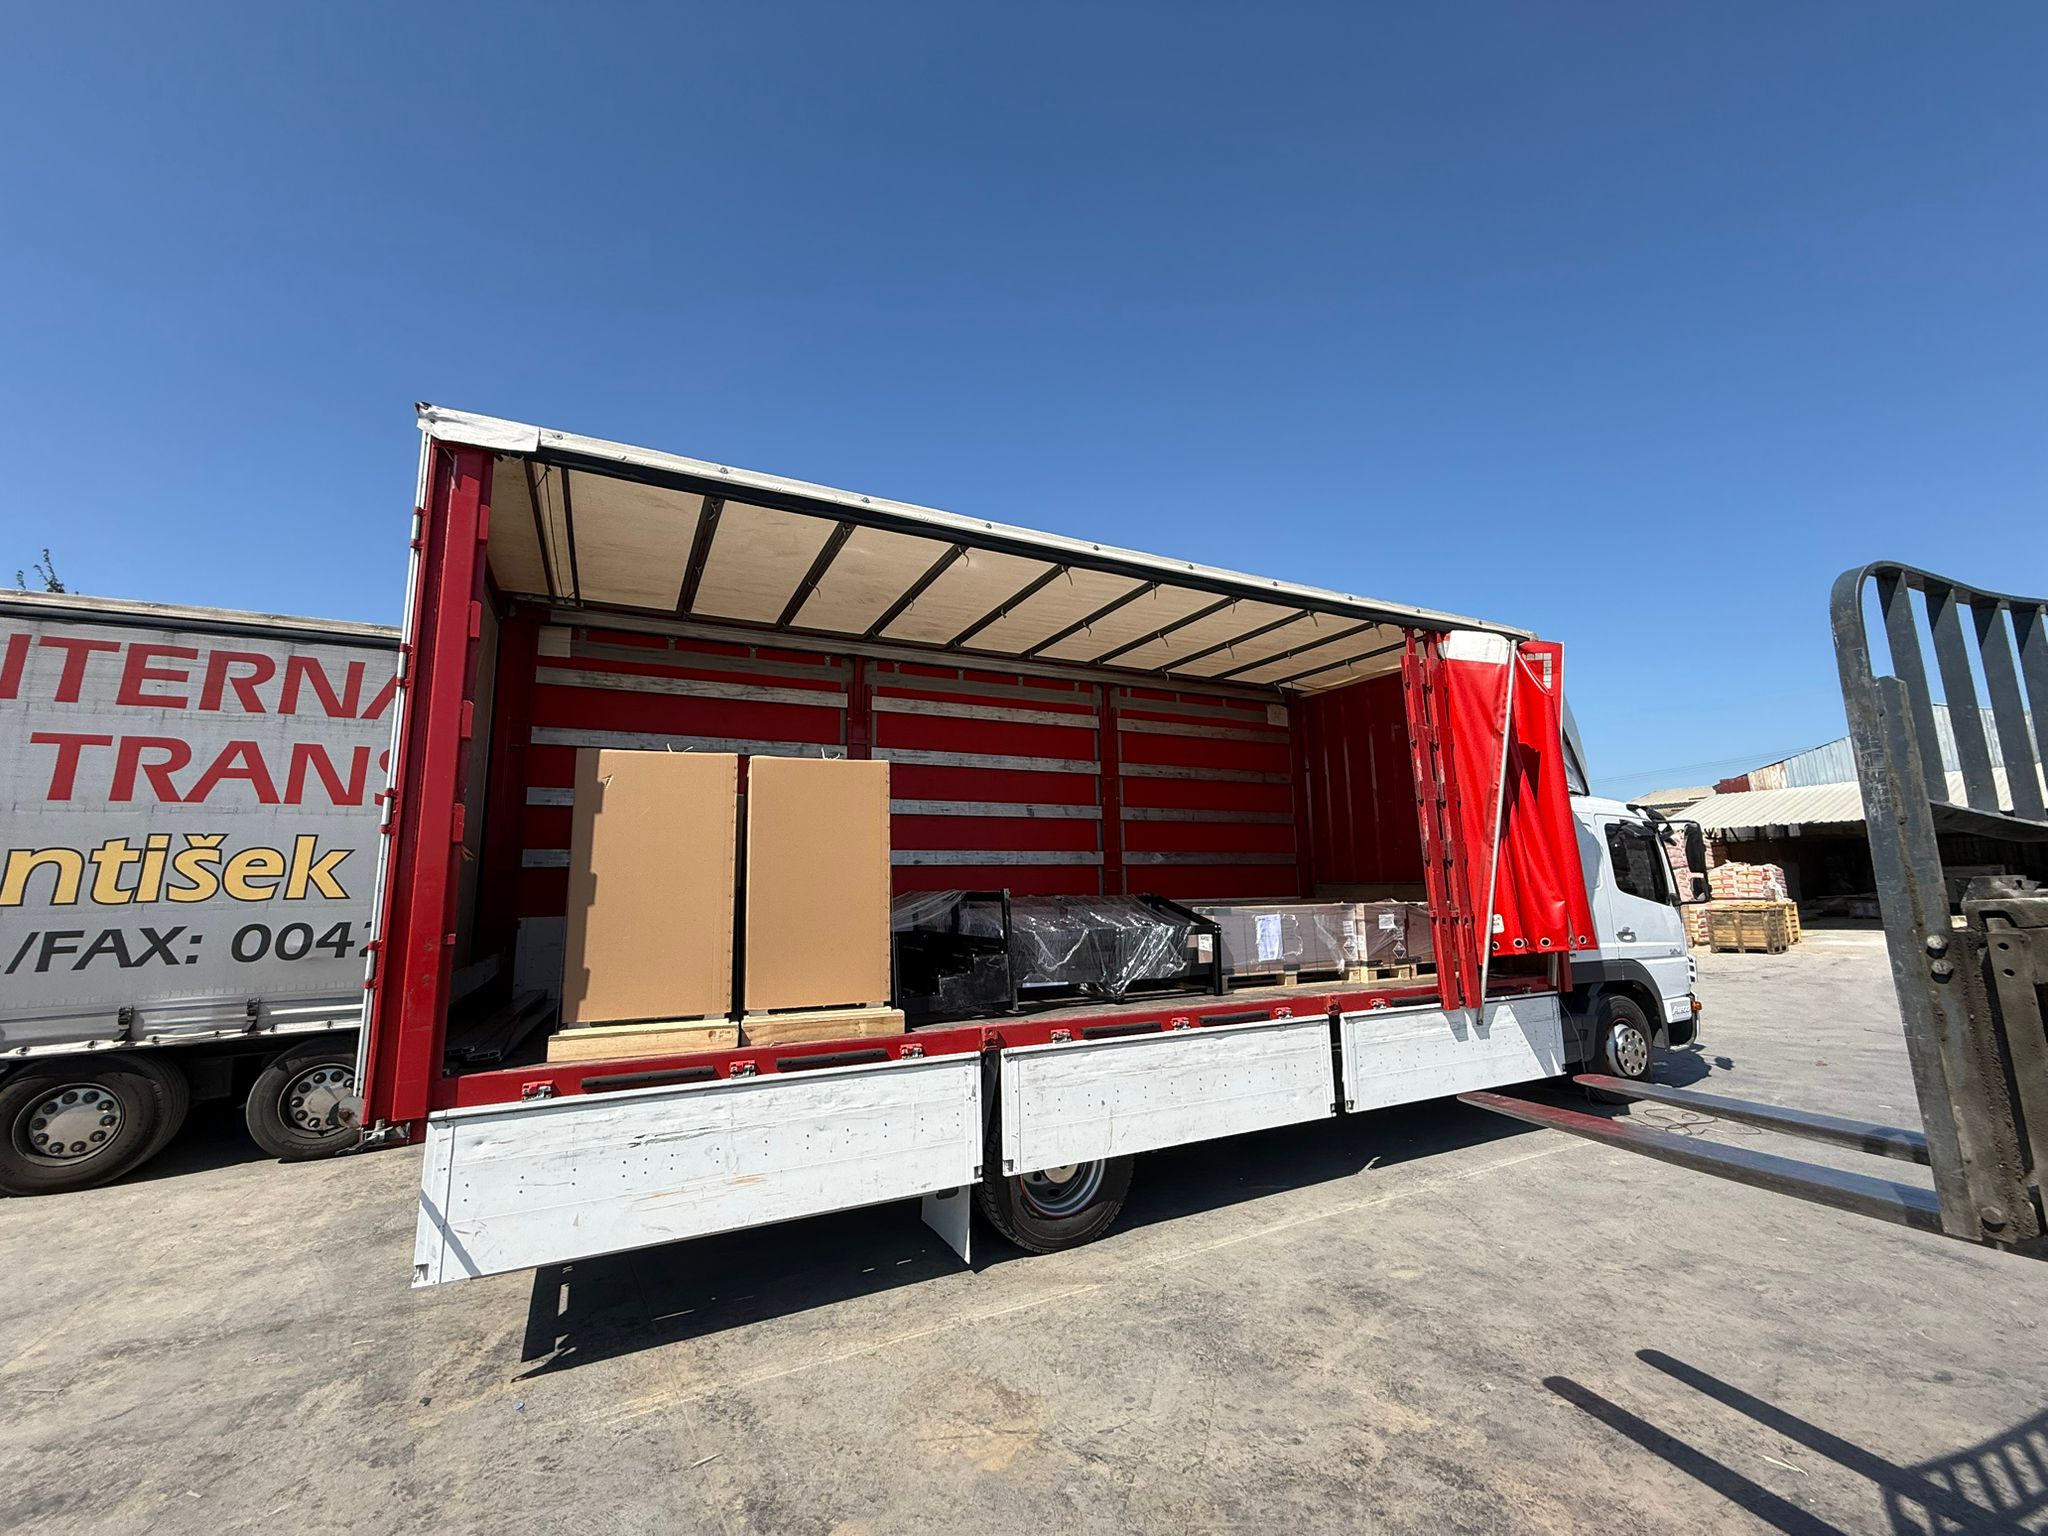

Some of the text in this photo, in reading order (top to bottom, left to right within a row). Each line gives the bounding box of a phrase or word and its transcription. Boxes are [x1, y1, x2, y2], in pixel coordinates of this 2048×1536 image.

[30, 731, 390, 806] TRAN
[0, 833, 355, 907] ntišek
[230, 921, 372, 963] 004
